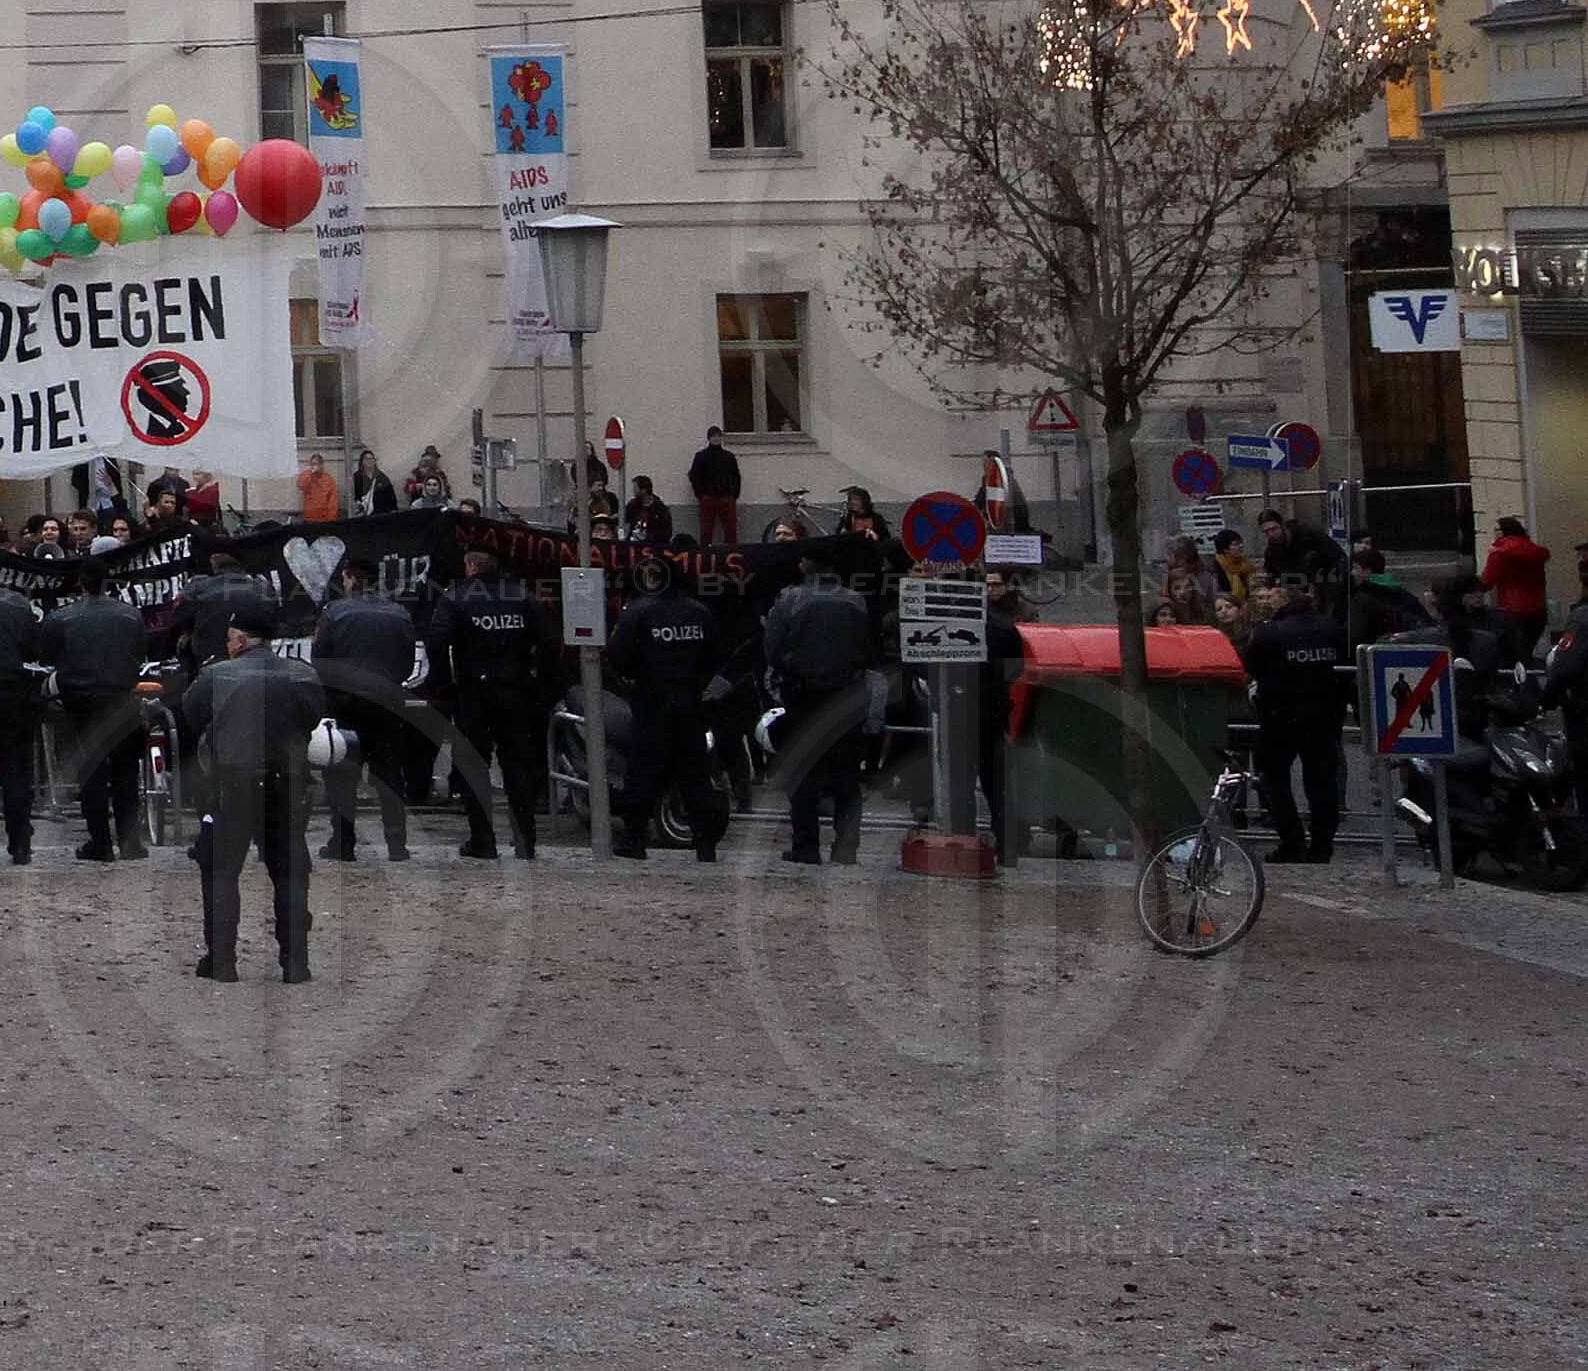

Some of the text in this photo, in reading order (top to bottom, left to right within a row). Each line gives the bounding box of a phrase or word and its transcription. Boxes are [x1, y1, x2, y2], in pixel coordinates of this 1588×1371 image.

[509, 165, 550, 190] AIDS
[503, 191, 568, 219] geht uns
[53, 275, 226, 349] GEGEN
[377, 552, 432, 595] ÜR
[471, 613, 526, 631] POLIZEI
[650, 624, 705, 642] POLIZEI
